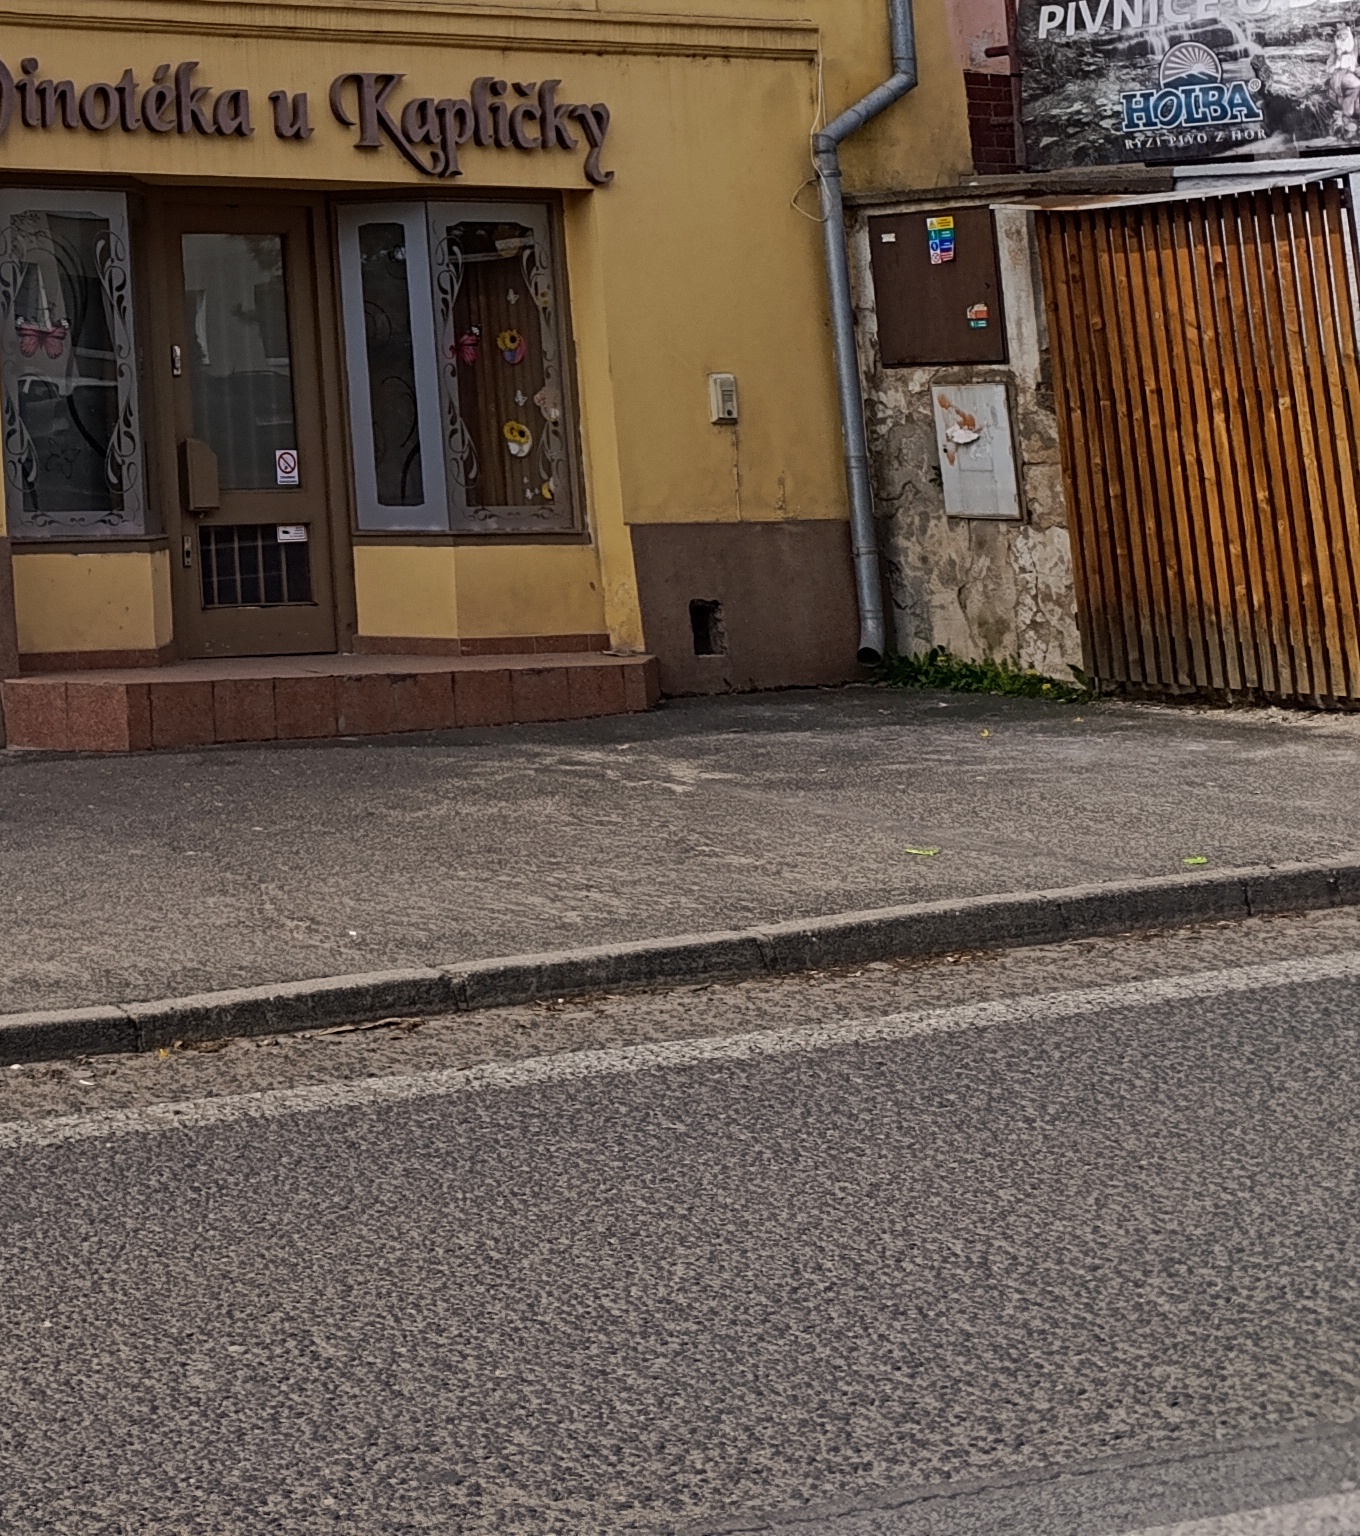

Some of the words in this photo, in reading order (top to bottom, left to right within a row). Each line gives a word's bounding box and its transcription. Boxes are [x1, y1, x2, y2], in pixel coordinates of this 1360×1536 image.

[269, 89, 314, 139] u
[329, 71, 615, 186] Kapličky
[1120, 80, 1264, 133] HOLBA
[1169, 133, 1208, 147] PIVO
[1215, 131, 1224, 143] Z
[1231, 129, 1267, 142] HOR
